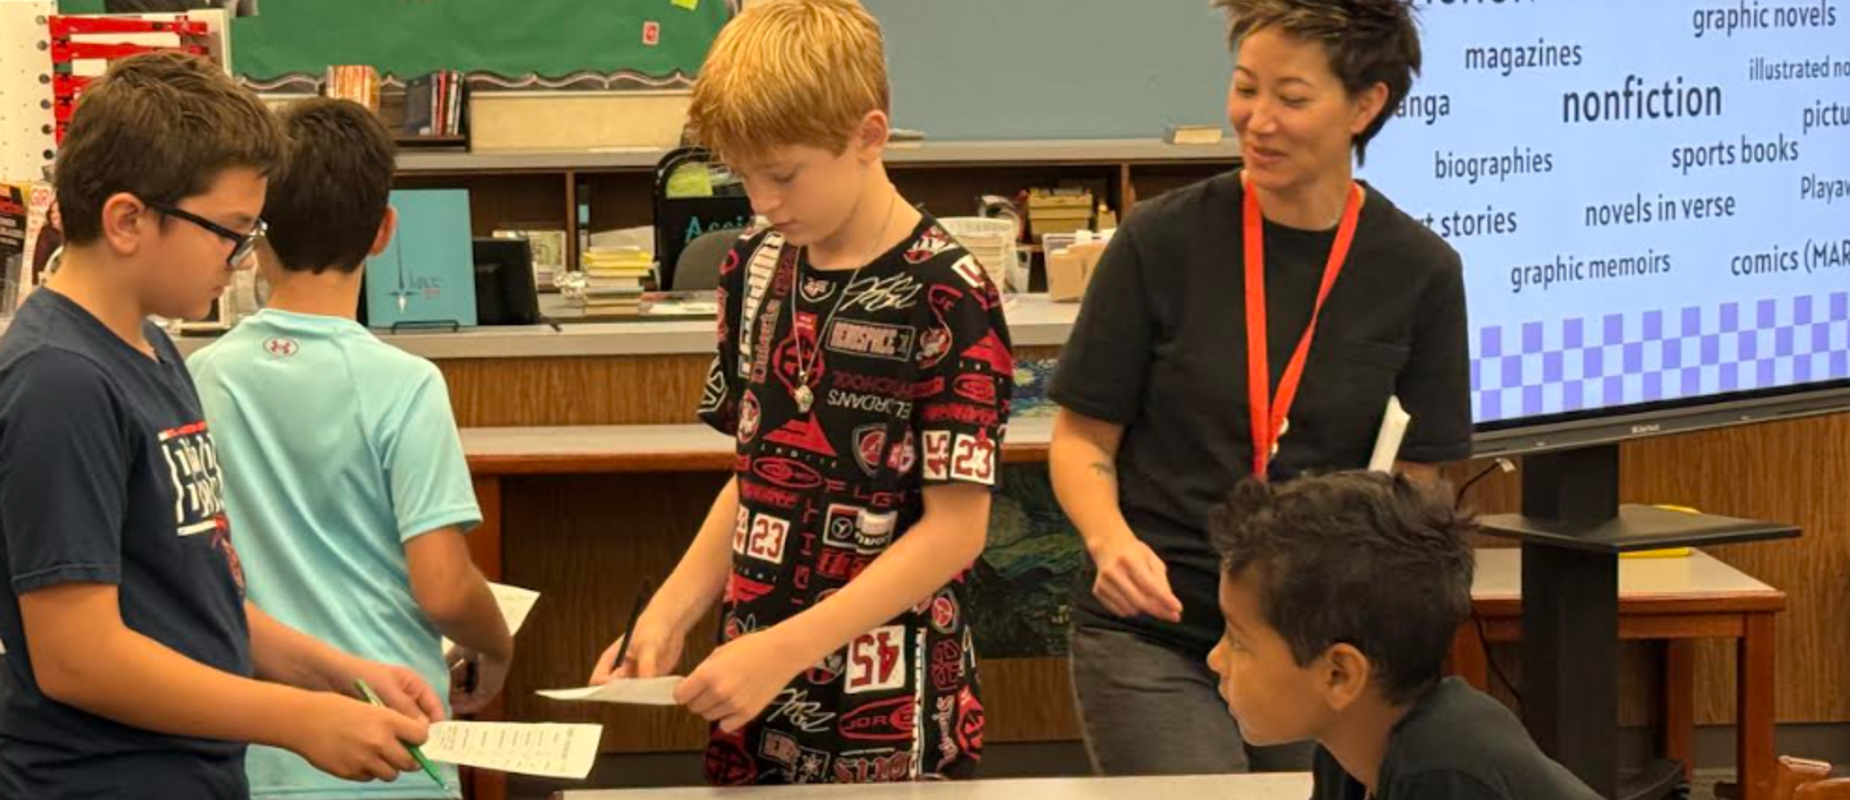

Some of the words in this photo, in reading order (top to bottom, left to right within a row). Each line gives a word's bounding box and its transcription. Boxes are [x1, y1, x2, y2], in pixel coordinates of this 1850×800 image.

[1693, 0, 1769, 38] graphic
[1774, 0, 1836, 28] novels
[1465, 37, 1582, 77] magazines
[1749, 55, 1830, 81] illustrated
[1563, 74, 1722, 123] nonfiction
[1803, 99, 1850, 134] pictu
[1435, 146, 1553, 184] biographies
[1672, 142, 1736, 176] sports
[1741, 133, 1799, 164] books
[1441, 205, 1518, 237] stories
[1586, 194, 1652, 227] novels
[1658, 193, 1677, 220] in
[1681, 196, 1736, 219] verse
[1511, 255, 1584, 293] graphic
[1589, 249, 1672, 280] memoirs
[1731, 245, 1799, 276] comics
[1804, 239, 1850, 274] (MAR
[954, 439, 994, 480] 23
[749, 517, 785, 560] 23
[849, 631, 900, 688] 45
